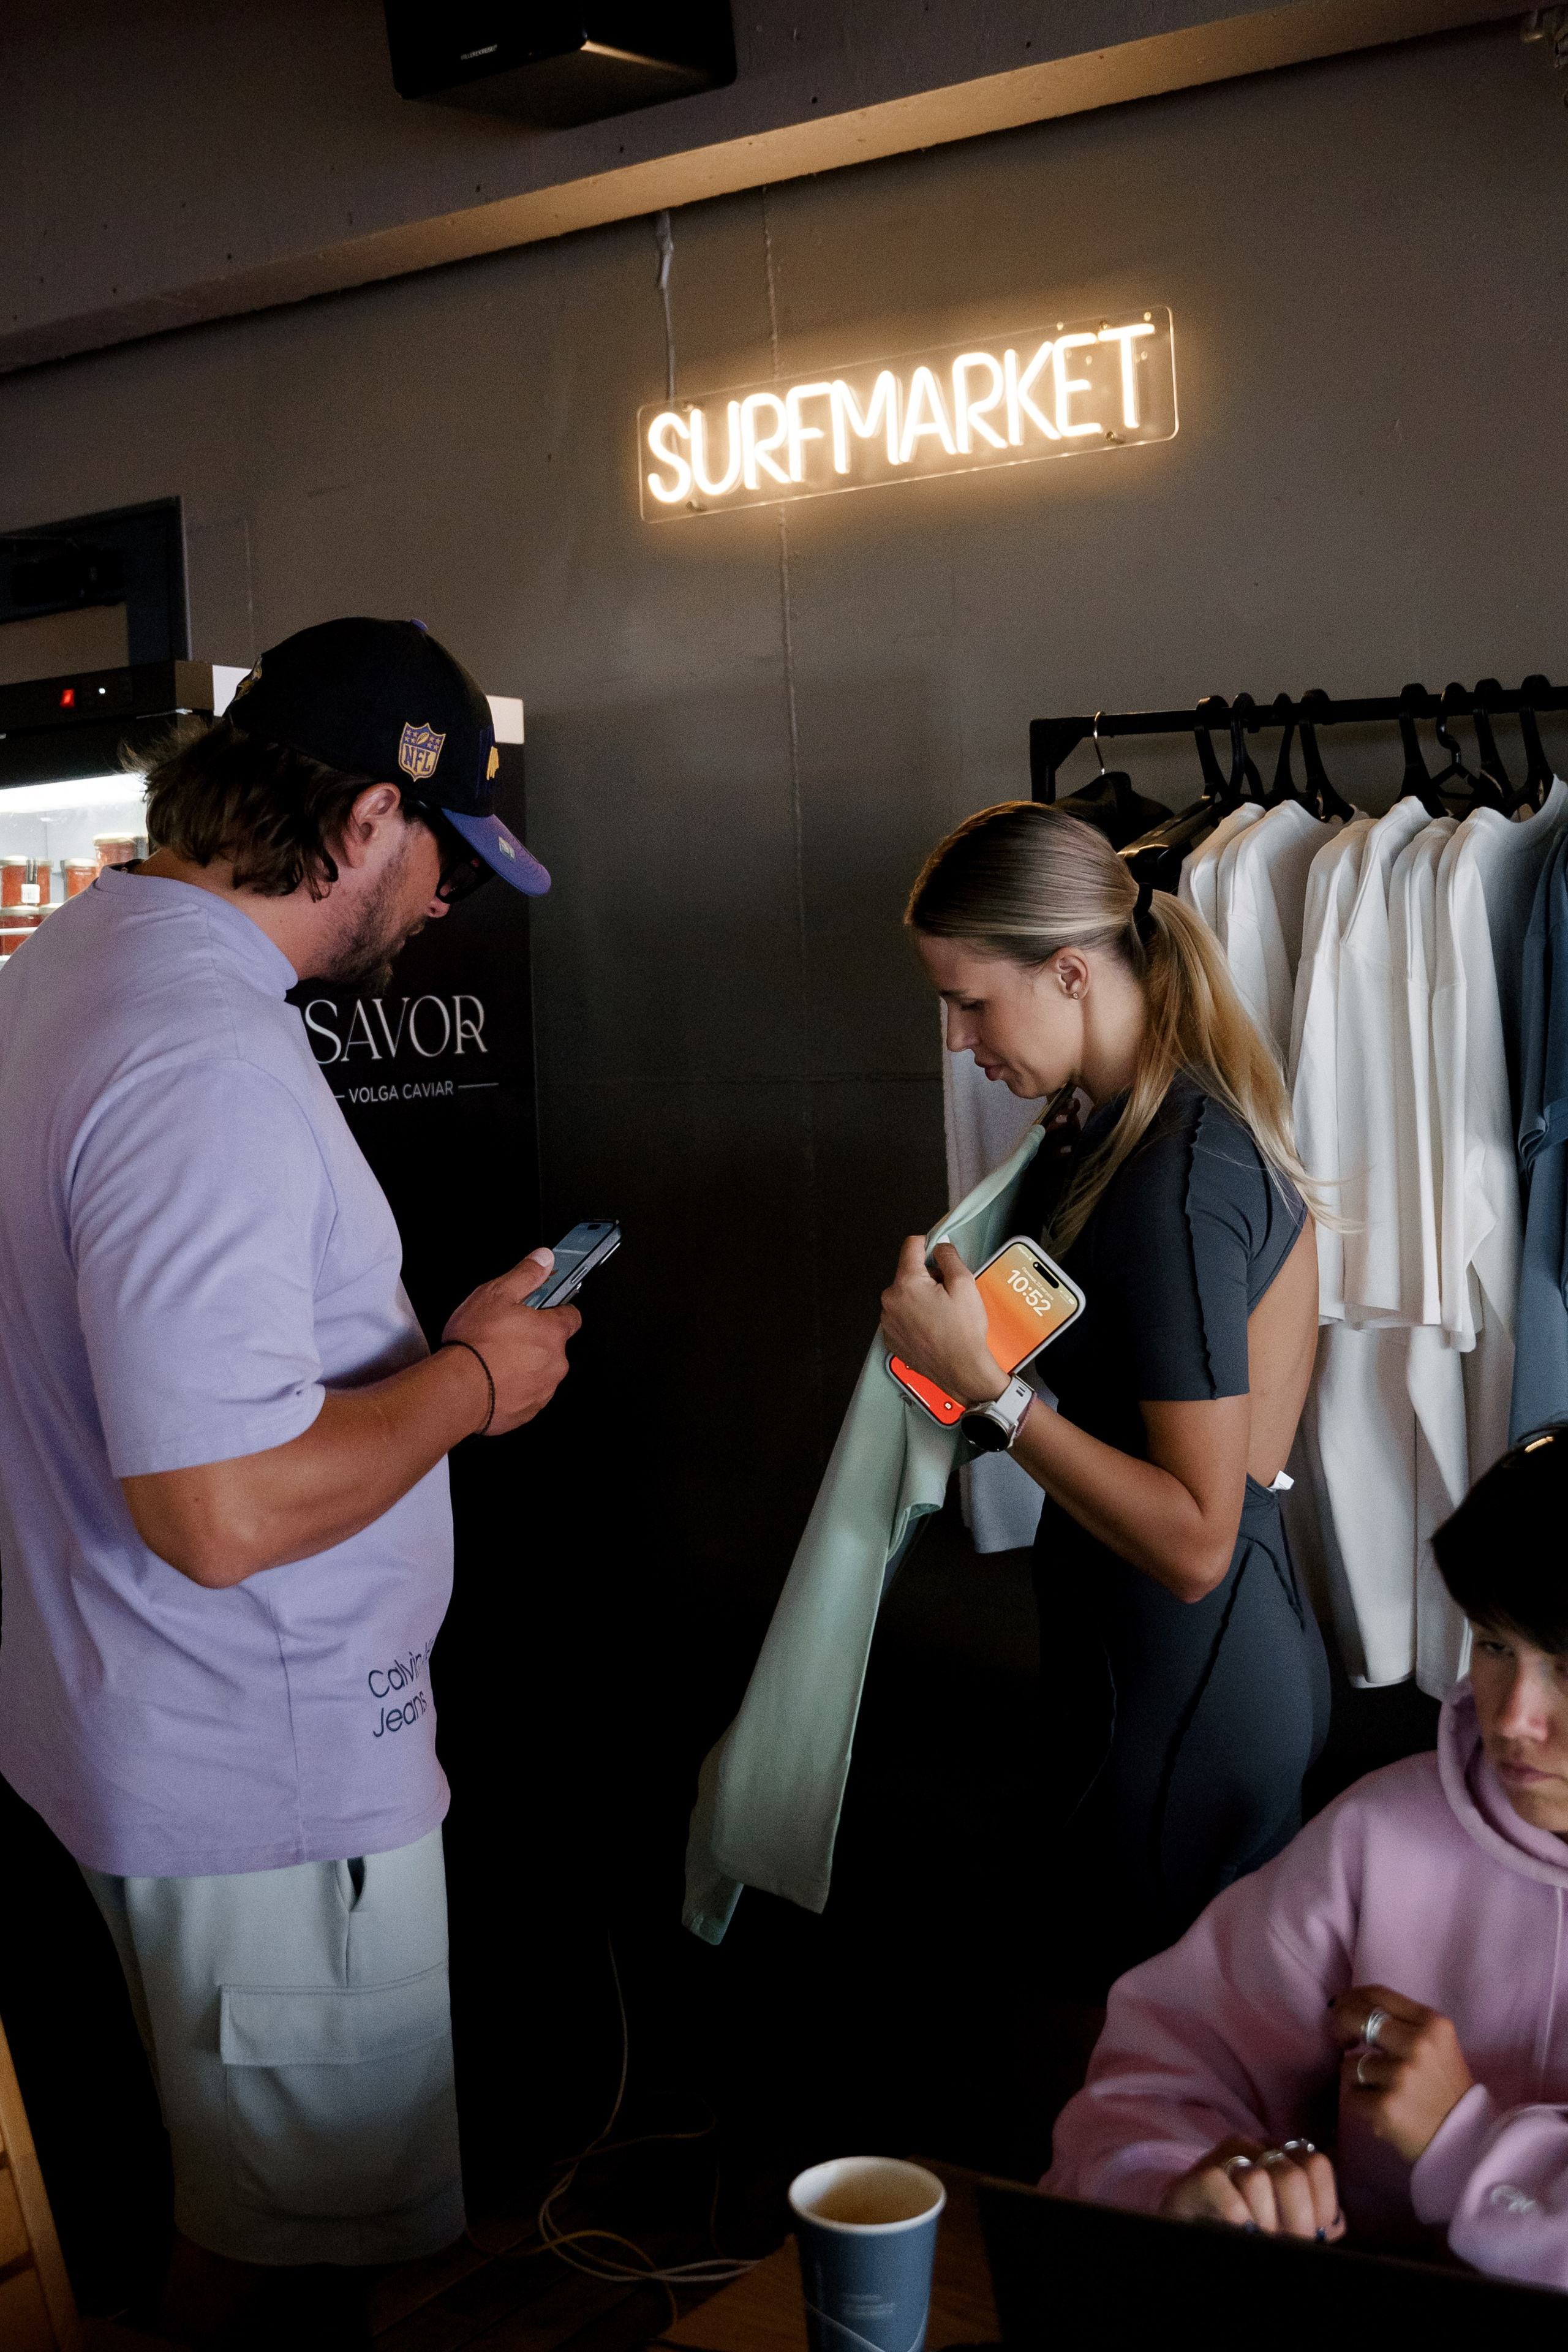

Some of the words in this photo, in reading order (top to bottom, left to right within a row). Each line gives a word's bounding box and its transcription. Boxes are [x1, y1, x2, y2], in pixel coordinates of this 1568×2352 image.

[648, 323, 1155, 503] SURFMARKET
[404, 745, 431, 772] NFL
[305, 995, 488, 1064] SAVOR
[349, 1085, 399, 1103] VOLGA
[402, 1080, 453, 1099] CAVIAR
[1007, 1270, 1051, 1317] 10:52
[373, 1691, 428, 1738] Jeans
